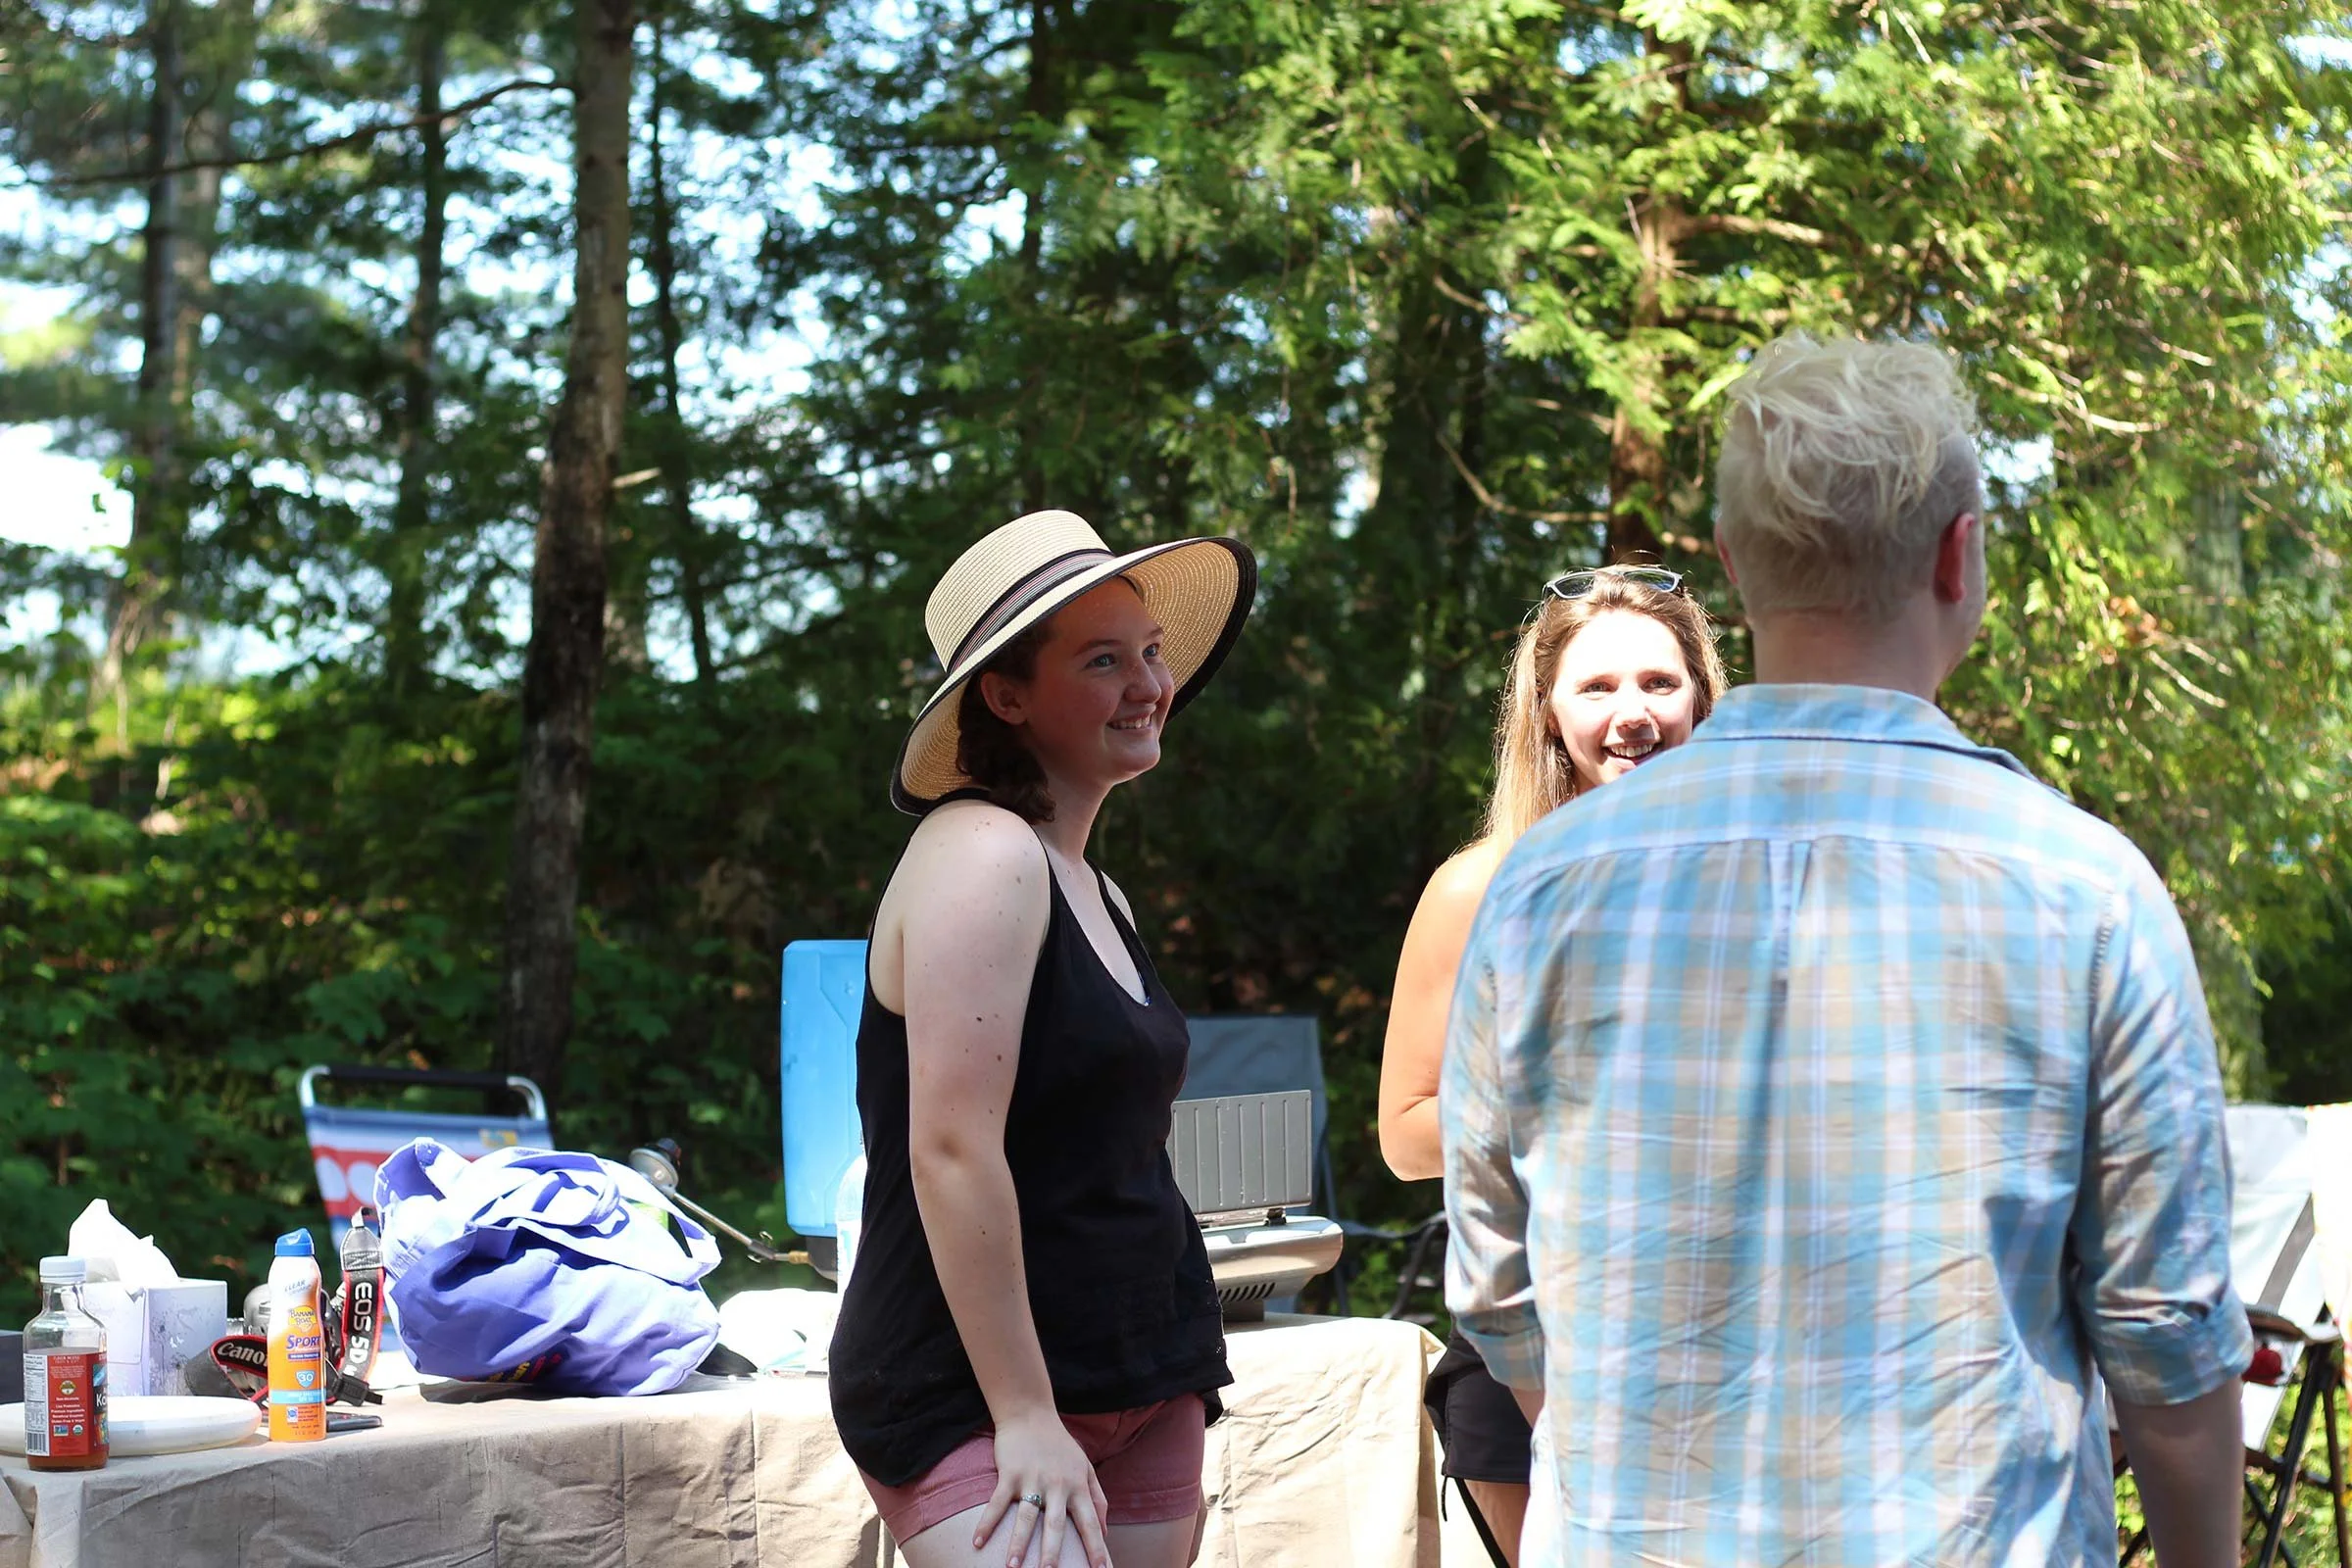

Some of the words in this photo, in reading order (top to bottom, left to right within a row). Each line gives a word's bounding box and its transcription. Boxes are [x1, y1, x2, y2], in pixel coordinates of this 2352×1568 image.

[289, 1308, 315, 1318] BANANA
[354, 1282, 372, 1331] EOS
[350, 1335, 369, 1364] 5D
[297, 1373, 314, 1382] 30
